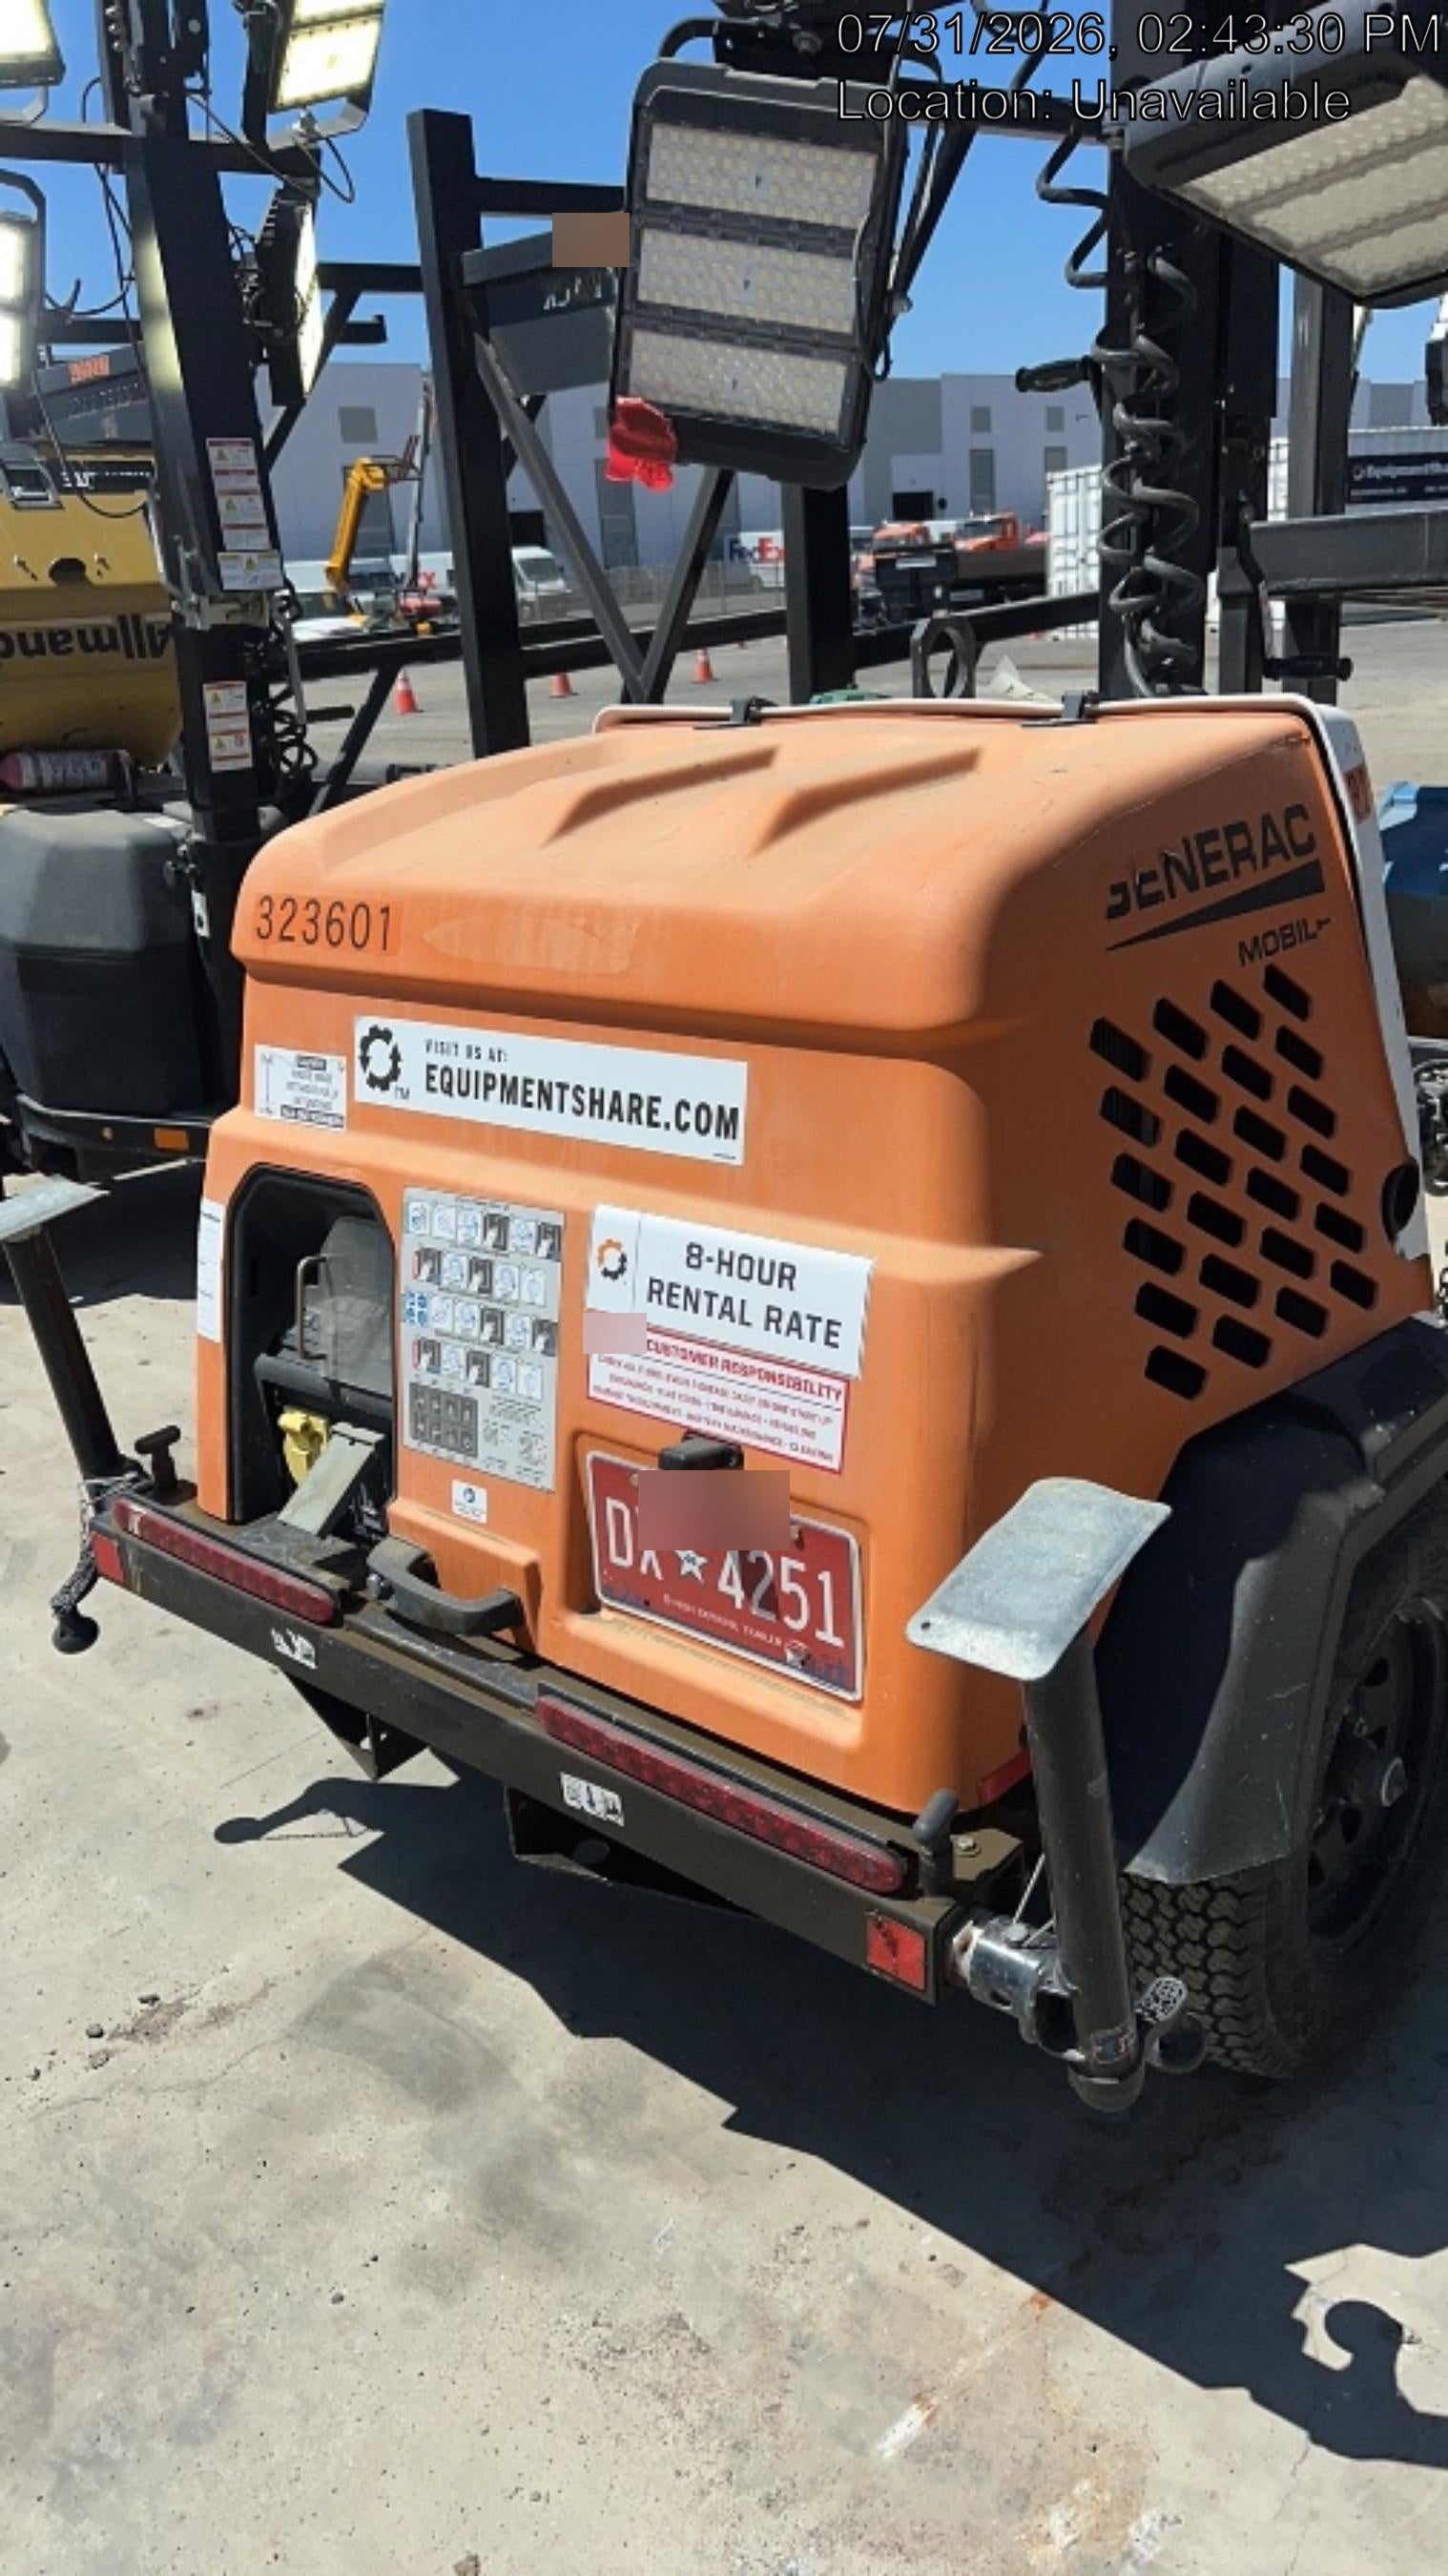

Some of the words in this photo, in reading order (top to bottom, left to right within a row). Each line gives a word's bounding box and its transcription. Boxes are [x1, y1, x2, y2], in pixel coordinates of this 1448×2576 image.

[256, 895, 390, 952] 323601
[424, 1038, 460, 1058] VISIT
[465, 1045, 482, 1061] US
[487, 1048, 507, 1063] AT:
[424, 1063, 740, 1140] EQUIPMENTSHARE.COM
[685, 1241, 797, 1292] 8-HOUR
[646, 1276, 754, 1328] RENTAL
[763, 1304, 842, 1349] RATE
[646, 1339, 719, 1368] CUSTOMER
[721, 1358, 842, 1402] RESPONSIBILITY
[717, 1542, 845, 1650] 4251
